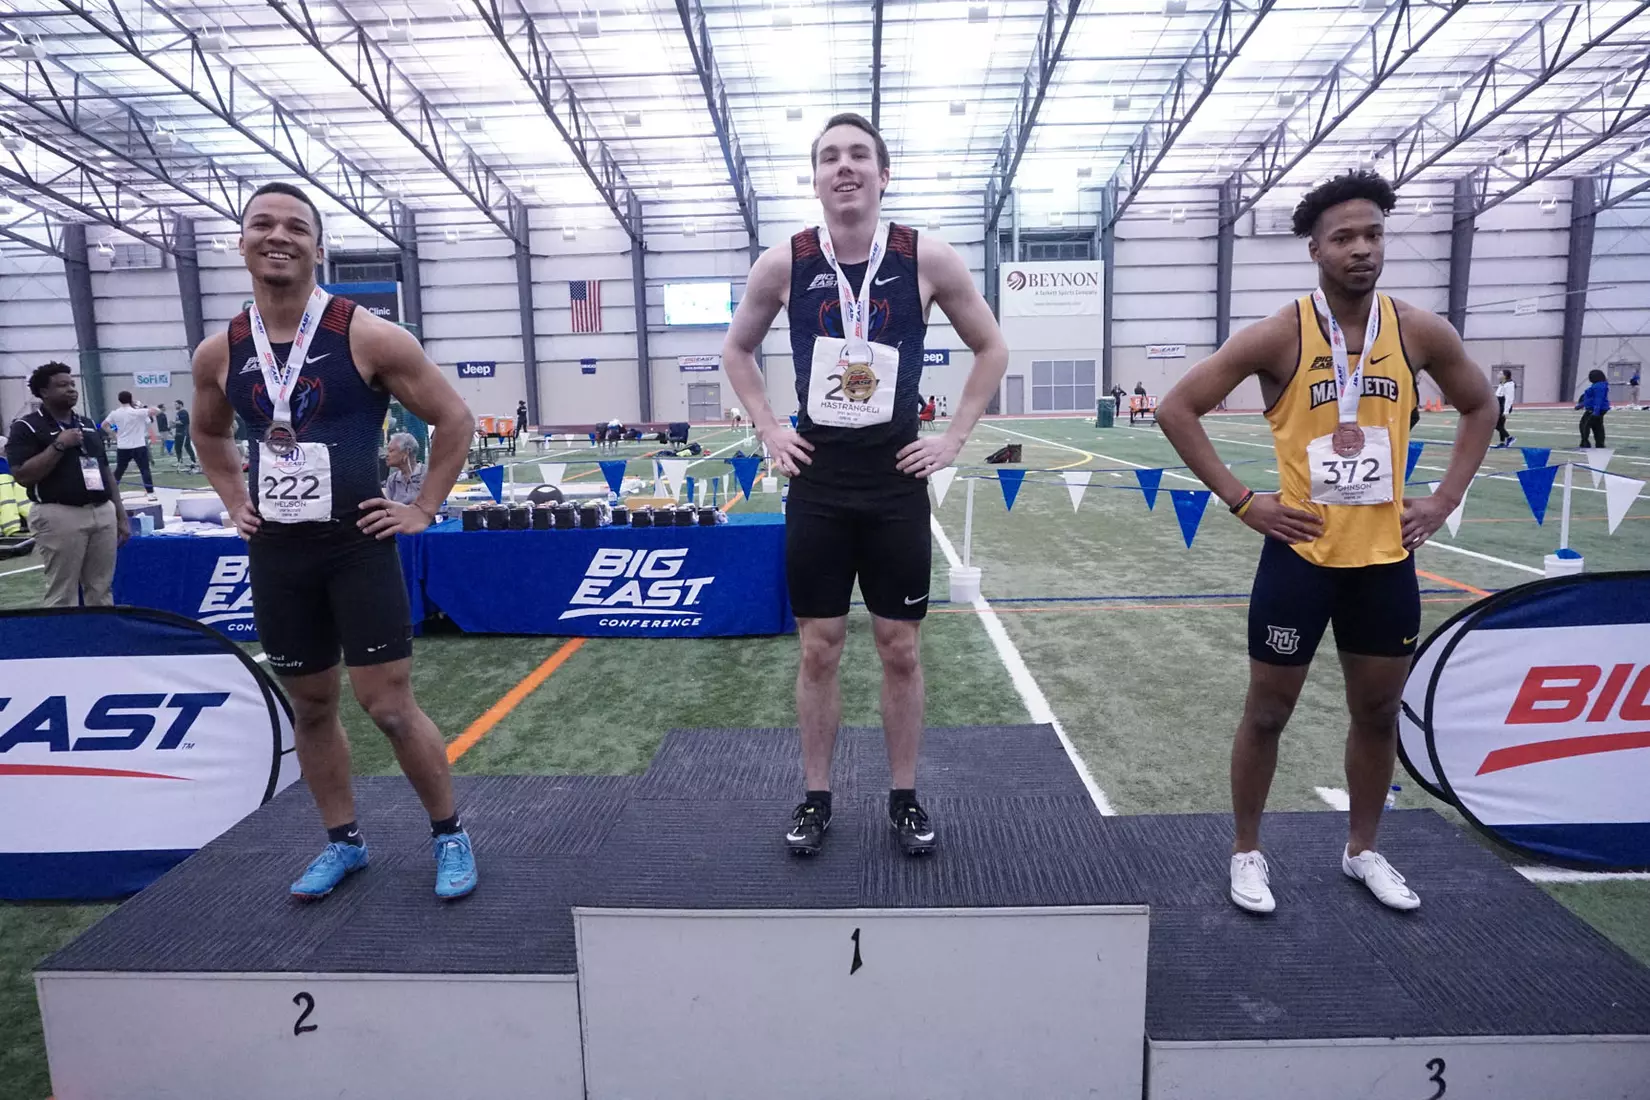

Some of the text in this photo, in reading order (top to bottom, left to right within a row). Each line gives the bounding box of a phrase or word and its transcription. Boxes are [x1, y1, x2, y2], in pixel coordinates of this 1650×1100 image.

[813, 273, 836, 281] BIG
[1028, 272, 1099, 287] BEYNON
[300, 312, 311, 334] EAST
[463, 364, 490, 375] Jeep
[923, 353, 944, 363] eep
[137, 375, 157, 385] SoFi
[1322, 458, 1381, 485] 372
[264, 475, 320, 500] 222
[1334, 483, 1372, 492] JOHNSON
[584, 548, 689, 578] BIG
[569, 576, 715, 607] EAST
[598, 617, 703, 628] CONFERENCE
[0, 692, 231, 753] AST
[850, 927, 863, 976] 1
[292, 991, 318, 1036] 2
[1425, 1057, 1447, 1100] 3
